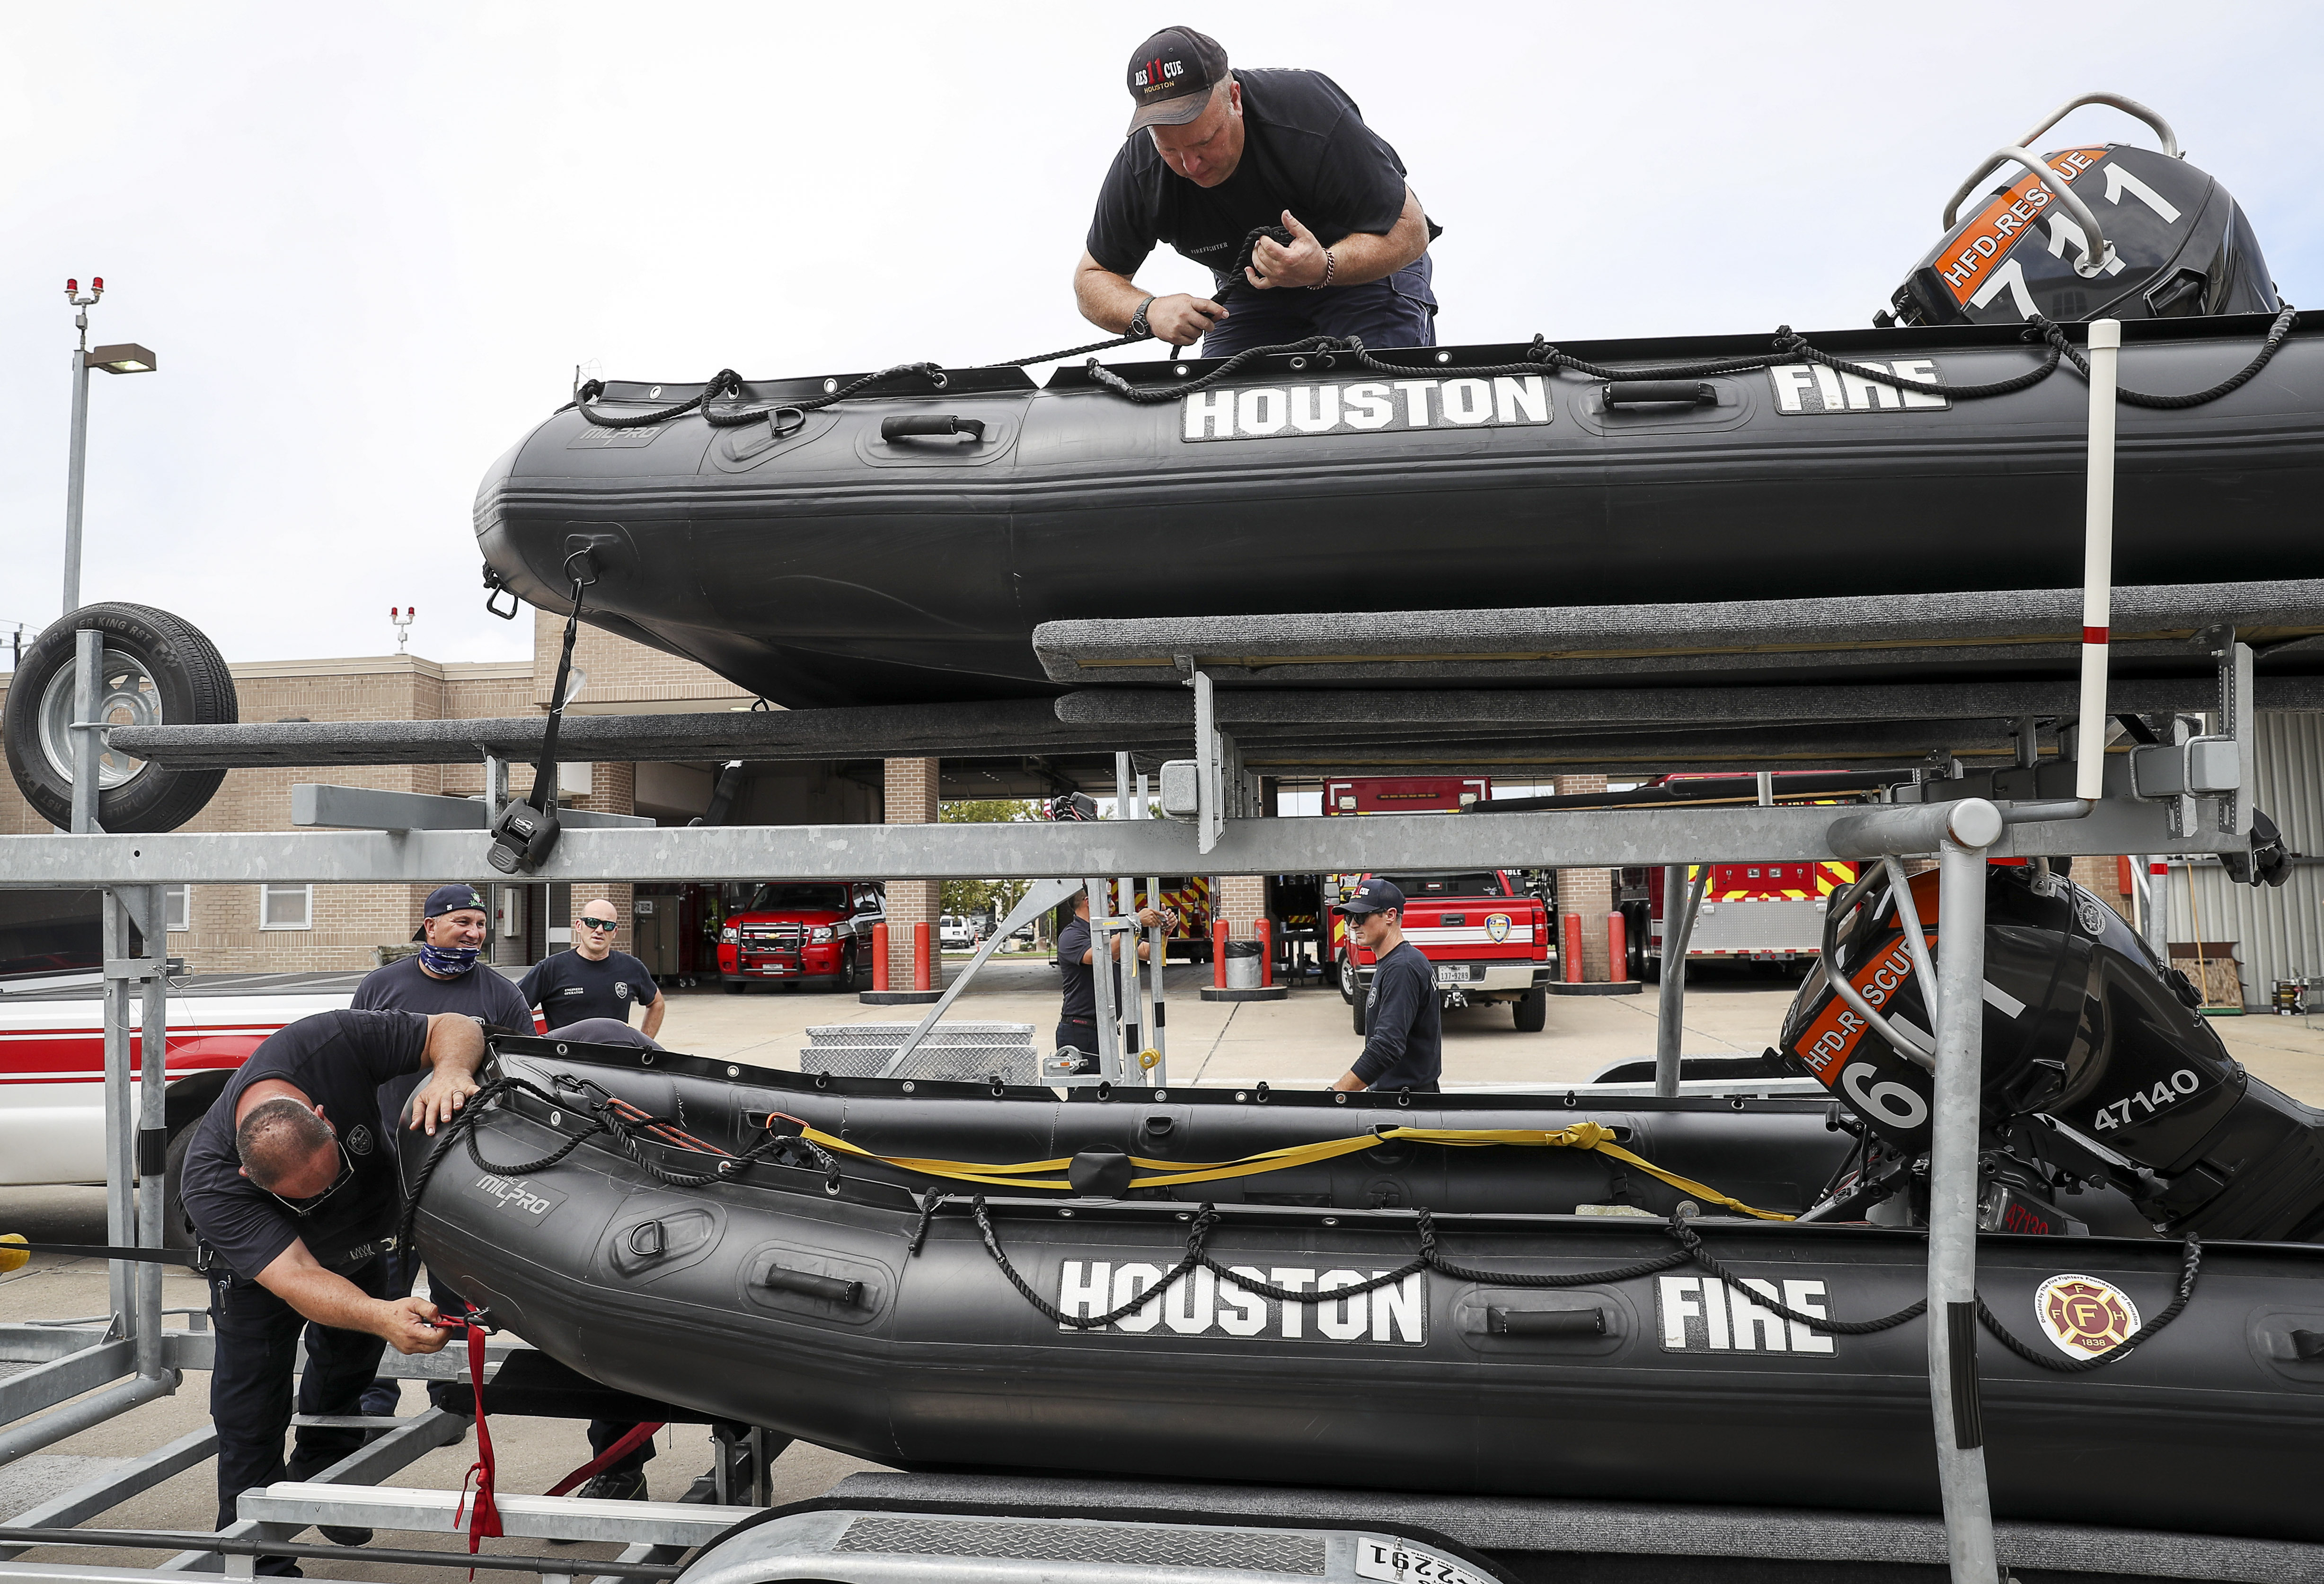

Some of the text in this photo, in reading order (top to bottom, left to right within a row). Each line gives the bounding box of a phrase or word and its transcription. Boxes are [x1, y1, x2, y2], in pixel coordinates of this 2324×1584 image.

[1144, 80, 1175, 94] HOUSTON
[1185, 360, 1946, 438] HOUSTON FIRE
[45, 617, 152, 646] TRAILER KING RST
[1803, 938, 1912, 1072] HFD-RSCU
[2095, 1069, 2199, 1130] 47140
[476, 1174, 551, 1214] MILPRO
[2040, 1284, 2049, 1292] The
[2074, 1285, 2084, 1293] F
[2085, 1277, 2121, 1295] Foundation
[1059, 1262, 1834, 1353] HOUSTON FIRE
[2037, 1299, 2046, 1323] Donated
[2051, 1309, 2061, 1319] F
[2073, 1303, 2098, 1327] F
[2112, 1311, 2126, 1320] H
[2126, 1302, 2138, 1325] Houston
